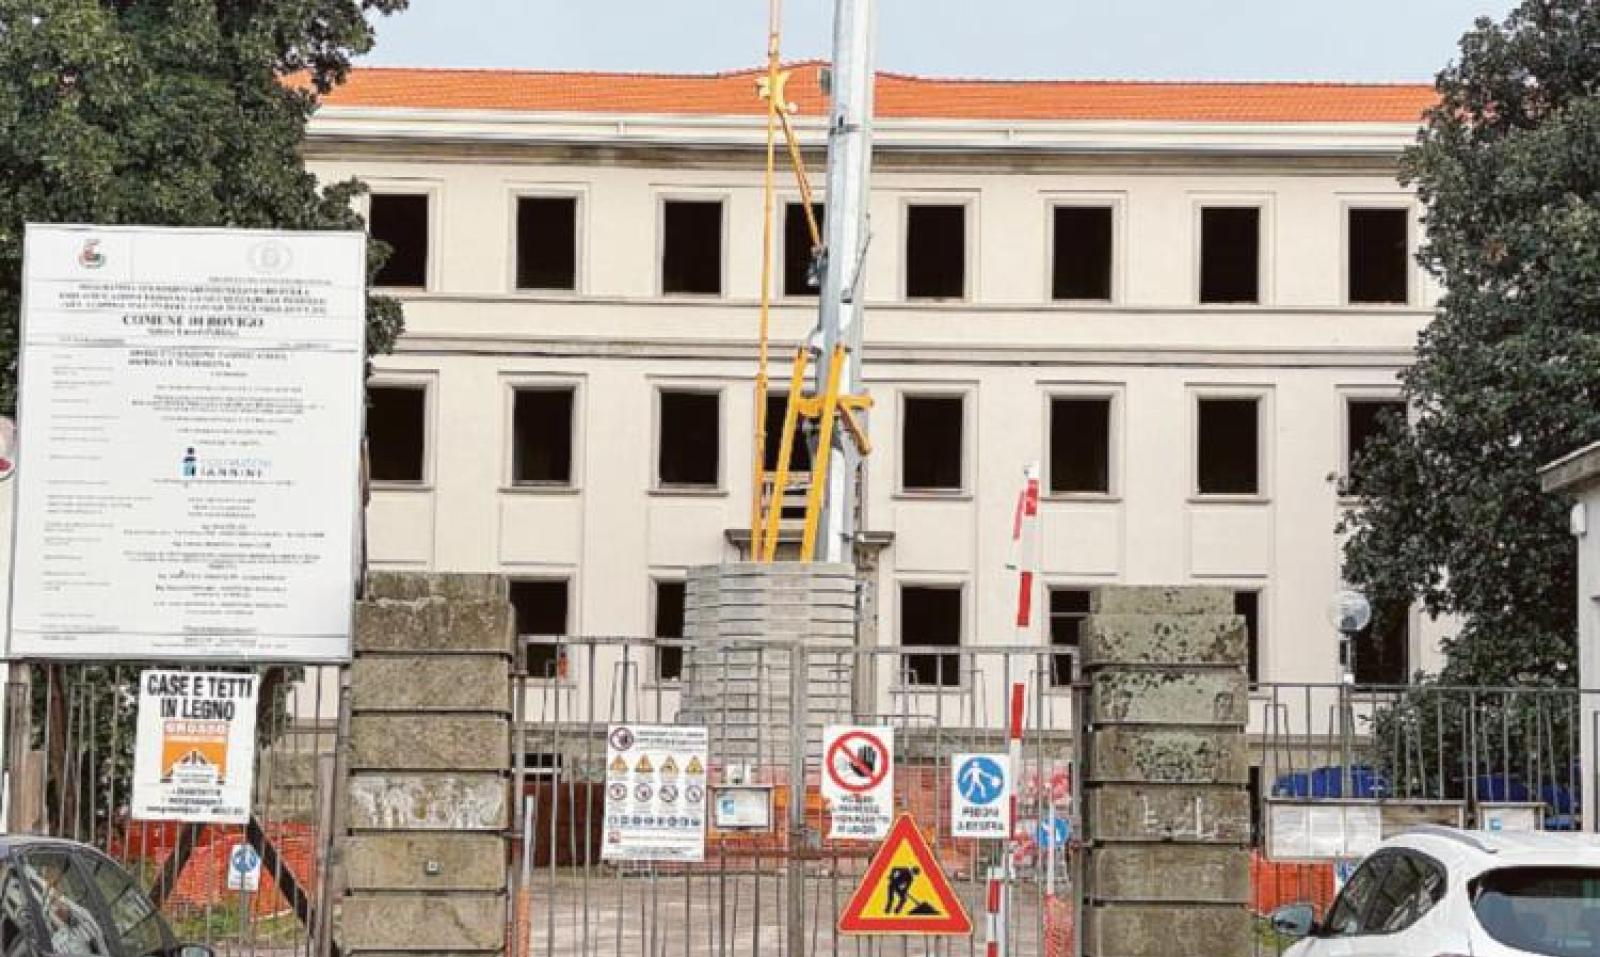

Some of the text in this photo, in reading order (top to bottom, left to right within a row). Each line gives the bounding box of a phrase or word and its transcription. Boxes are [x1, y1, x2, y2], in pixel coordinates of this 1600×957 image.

[122, 314, 184, 326] COMUNE
[147, 673, 253, 699] CASE E TETTI
[160, 698, 235, 721] IN LEGNO
